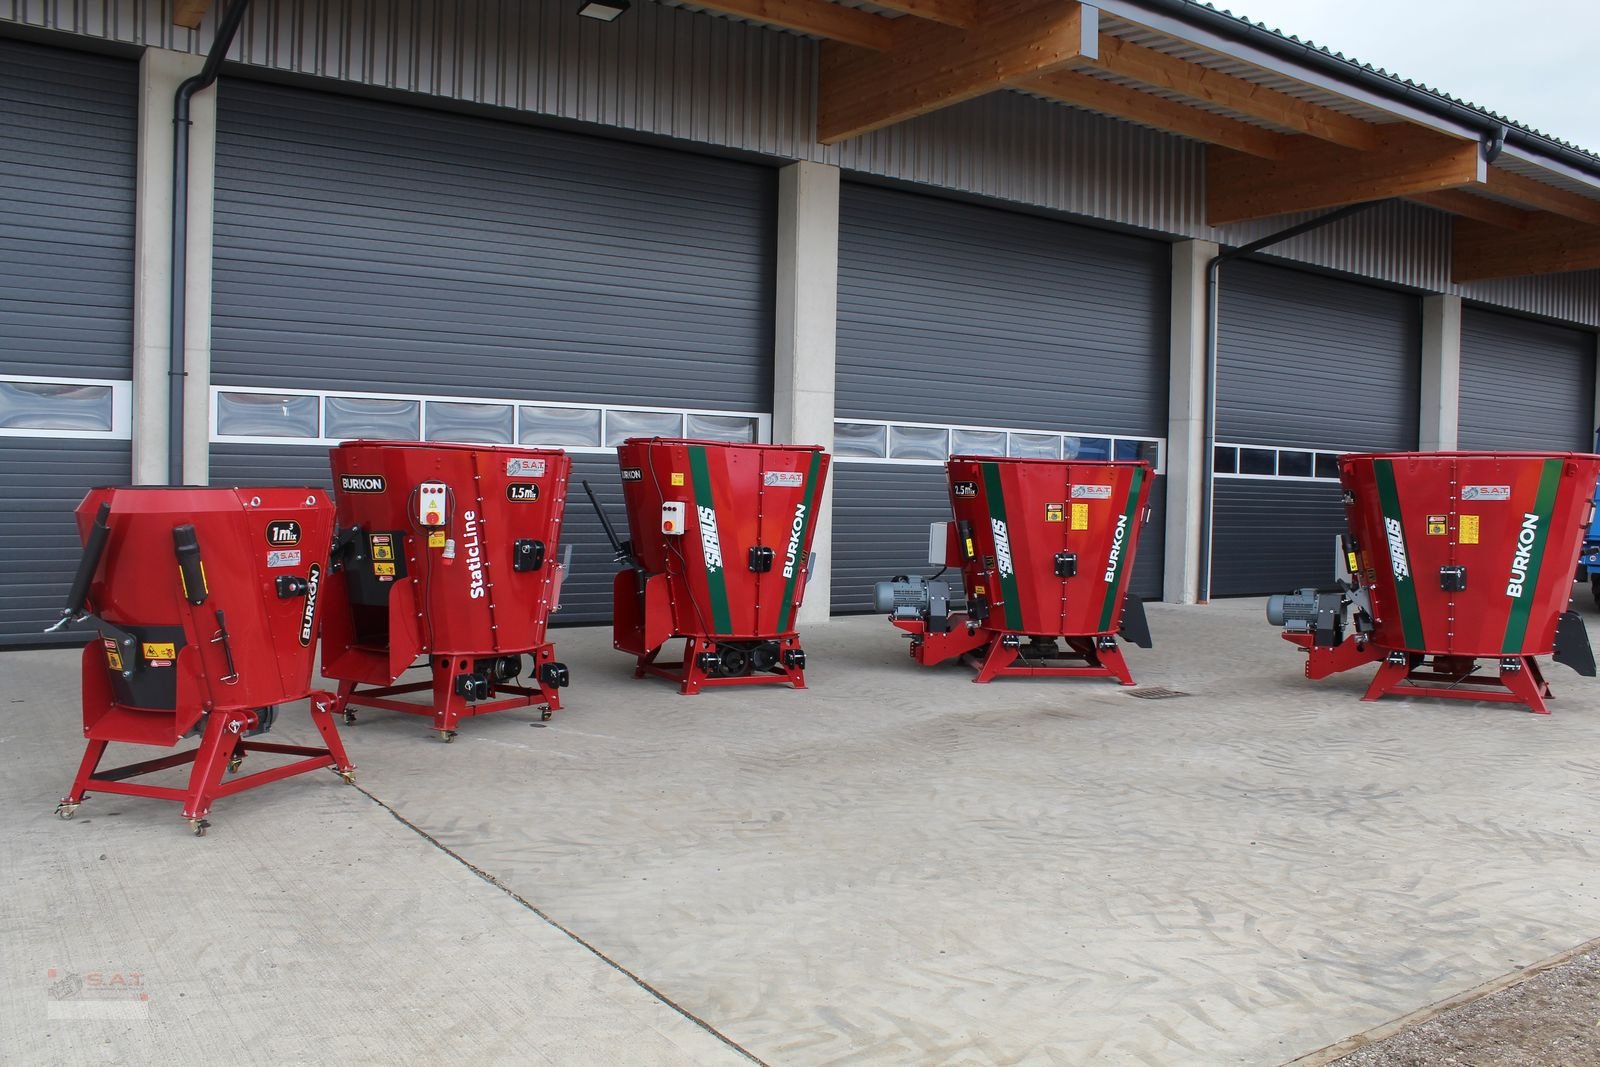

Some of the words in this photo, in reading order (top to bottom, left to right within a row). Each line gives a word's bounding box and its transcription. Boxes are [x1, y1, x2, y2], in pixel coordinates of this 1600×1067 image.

[342, 477, 383, 491] BURKON
[621, 470, 641, 480] URKON
[464, 511, 485, 600] StaticLine
[697, 505, 722, 568] SIRIUS
[783, 503, 807, 579] BURKON
[991, 517, 1014, 576] SIRIUS
[1104, 514, 1127, 584] BURKON
[1384, 516, 1409, 578] SIRIUS
[1506, 513, 1540, 598] BURKON
[302, 569, 320, 641] BURKON
